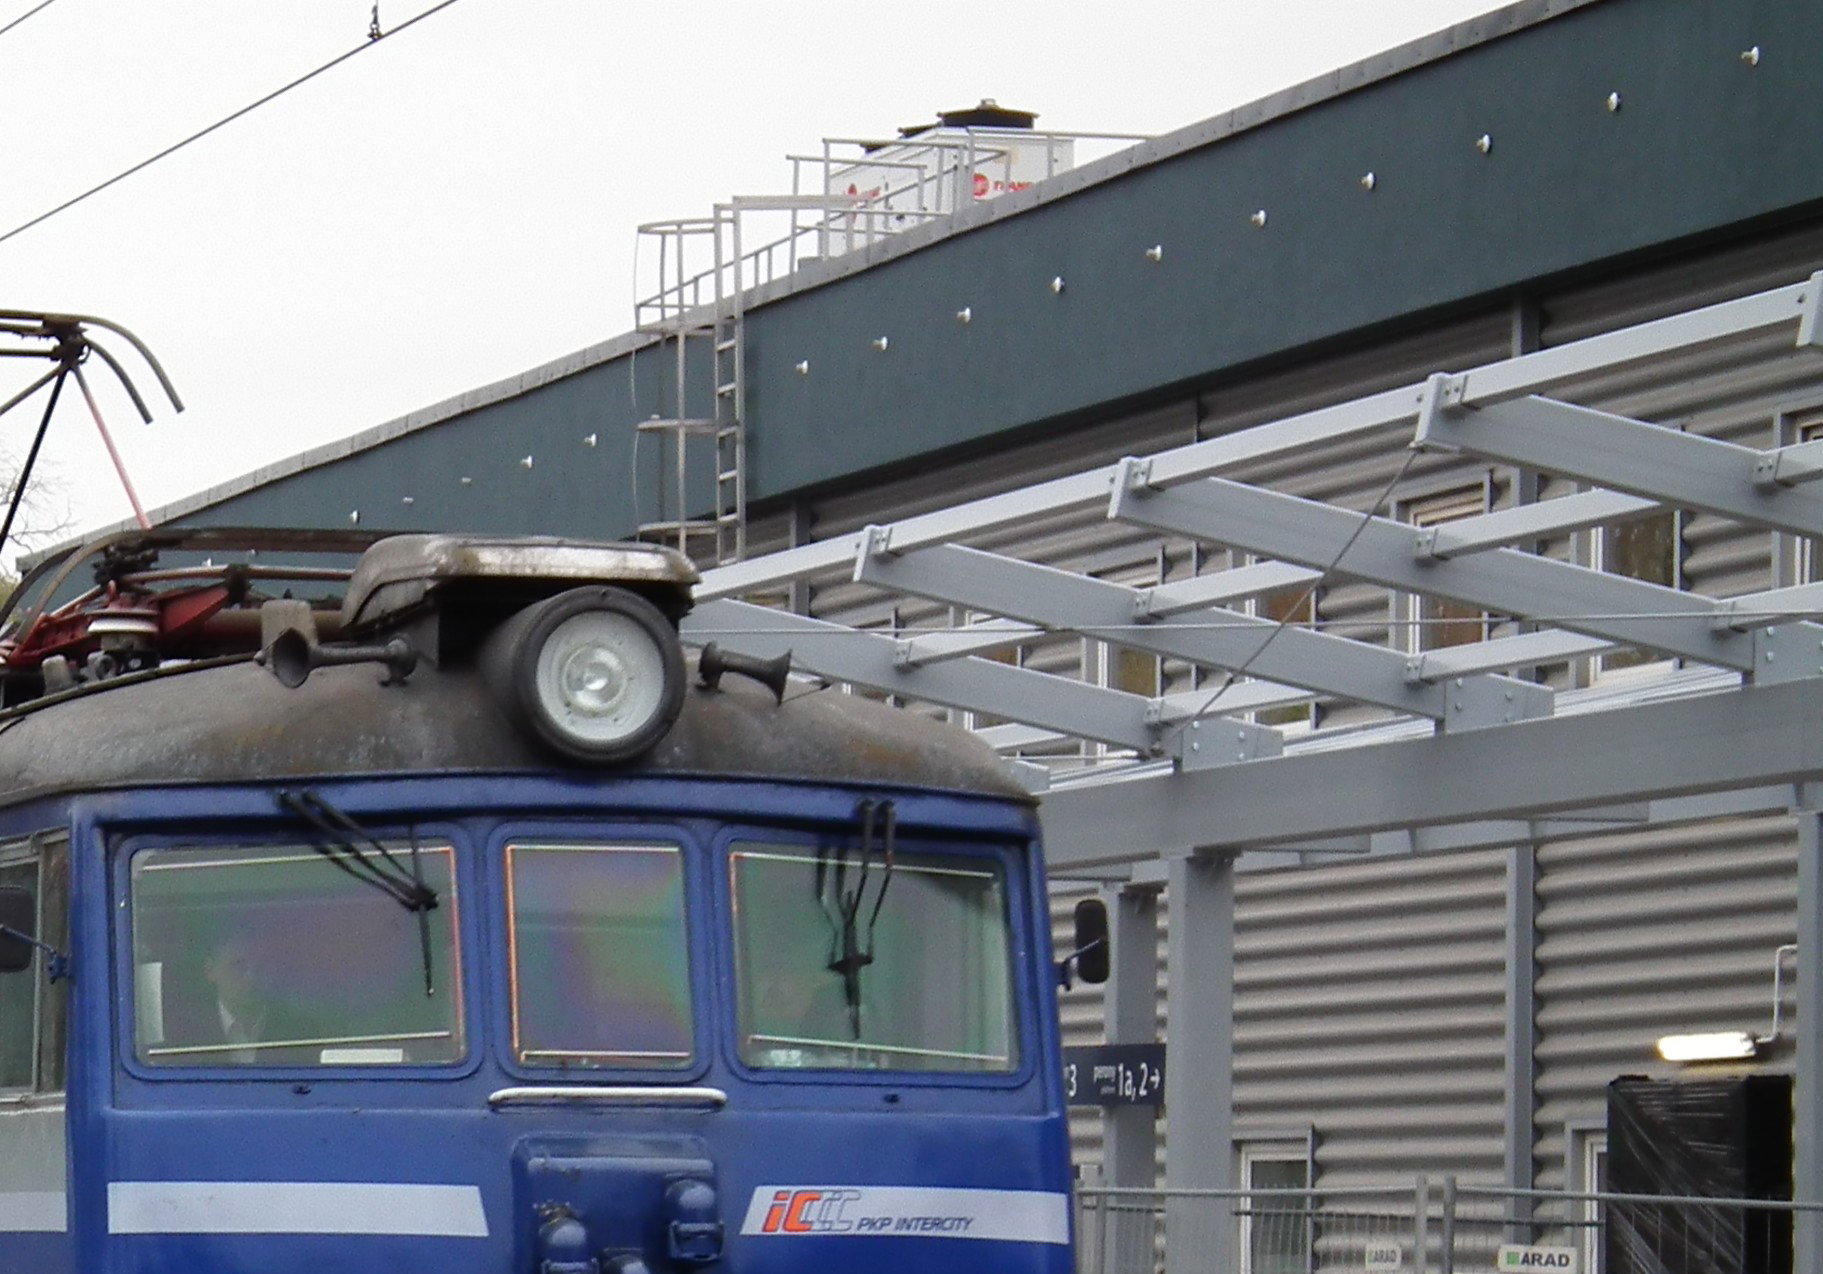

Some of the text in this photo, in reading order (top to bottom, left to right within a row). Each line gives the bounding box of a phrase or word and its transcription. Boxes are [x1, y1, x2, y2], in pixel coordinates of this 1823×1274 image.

[1139, 1062, 1148, 1097] 2
[857, 1217, 974, 1232] PKP INTERCITY
[1520, 1253, 1570, 1267] ARAD
